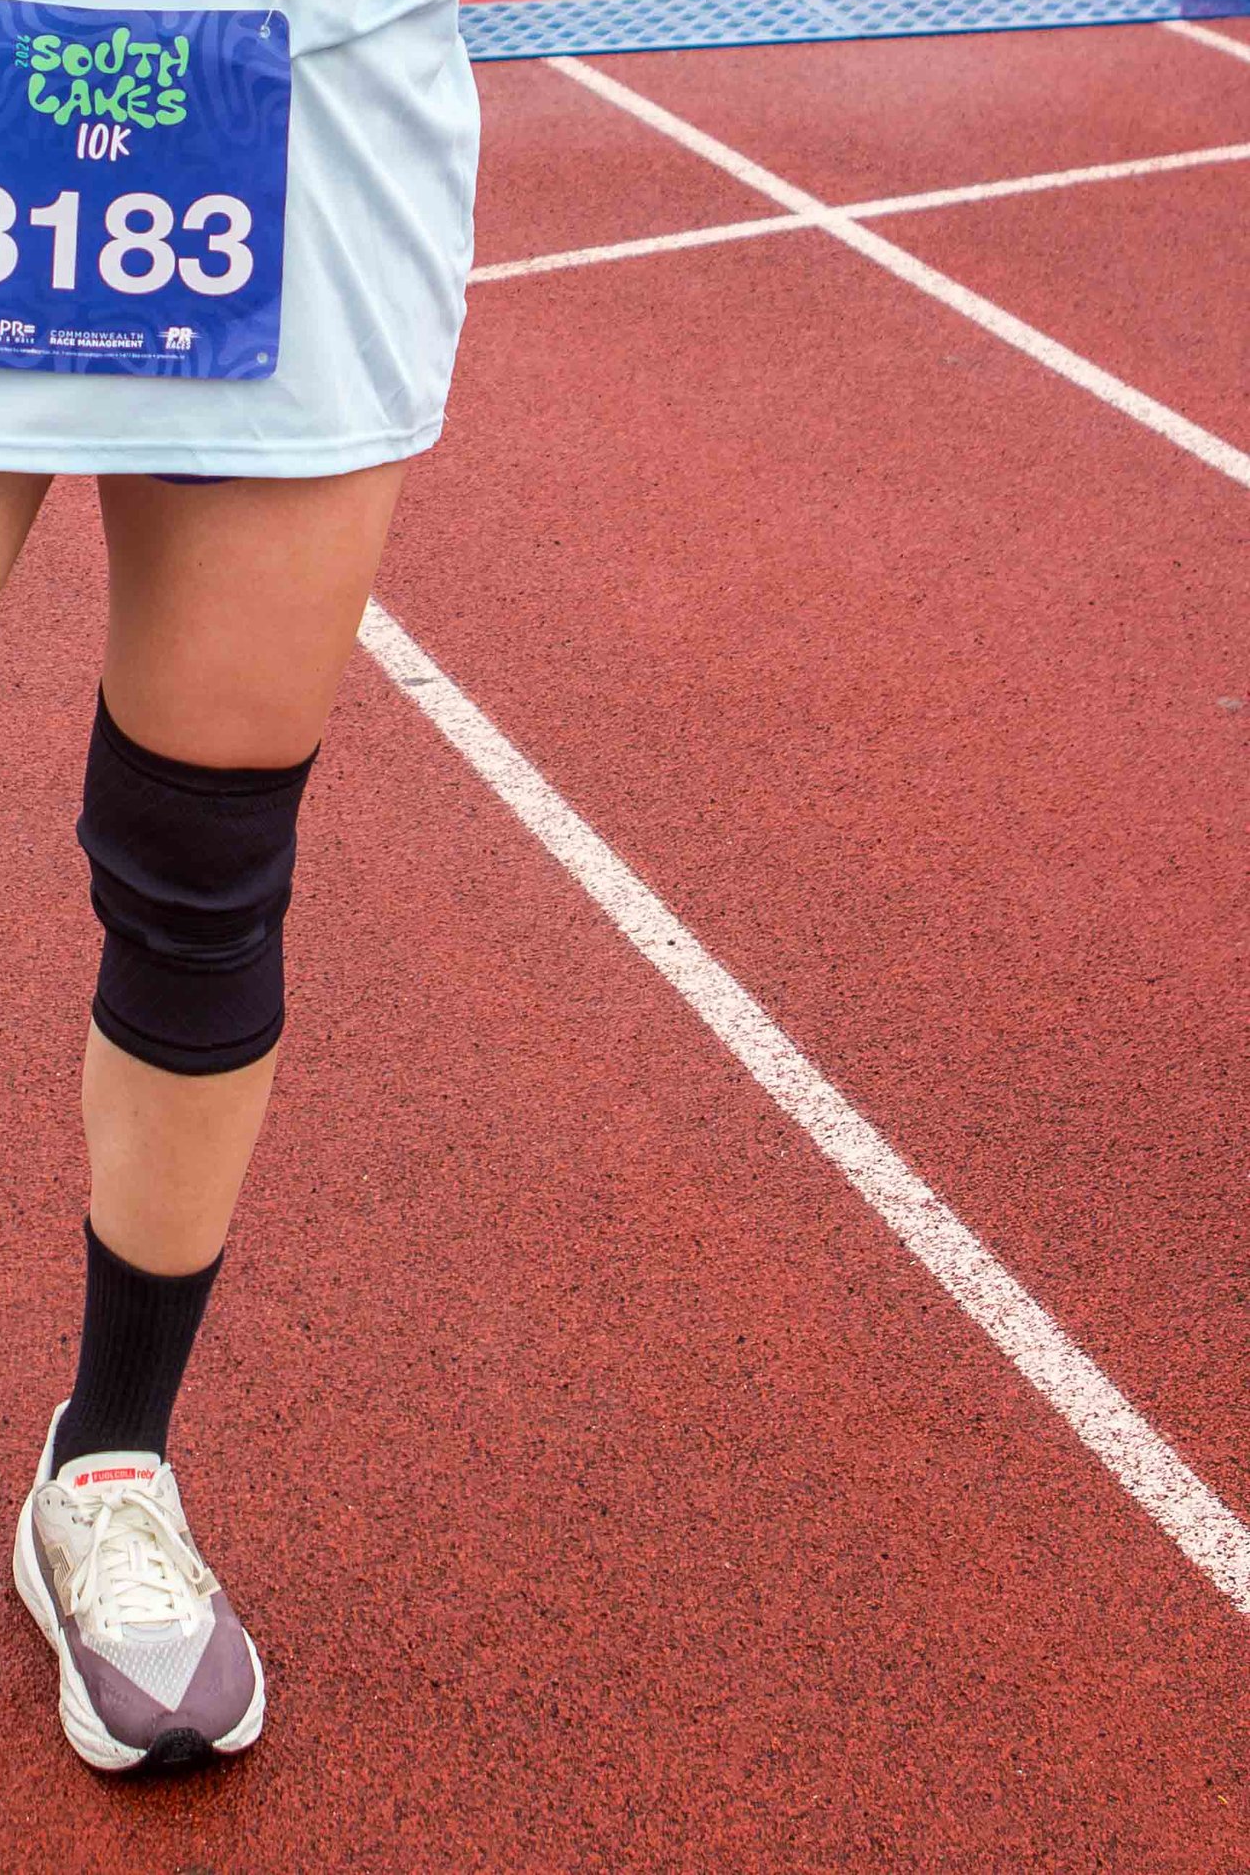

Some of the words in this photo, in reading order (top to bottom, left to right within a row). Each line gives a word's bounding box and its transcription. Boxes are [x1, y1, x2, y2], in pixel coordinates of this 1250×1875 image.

[13, 34, 31, 69] 2026
[30, 27, 190, 88] SOUTH
[28, 72, 188, 129] LAKES
[76, 122, 132, 162] 10K
[50, 329, 144, 340] COMMONWEALTH
[50, 337, 76, 347] RACE
[77, 338, 144, 348] MANAGEMENT
